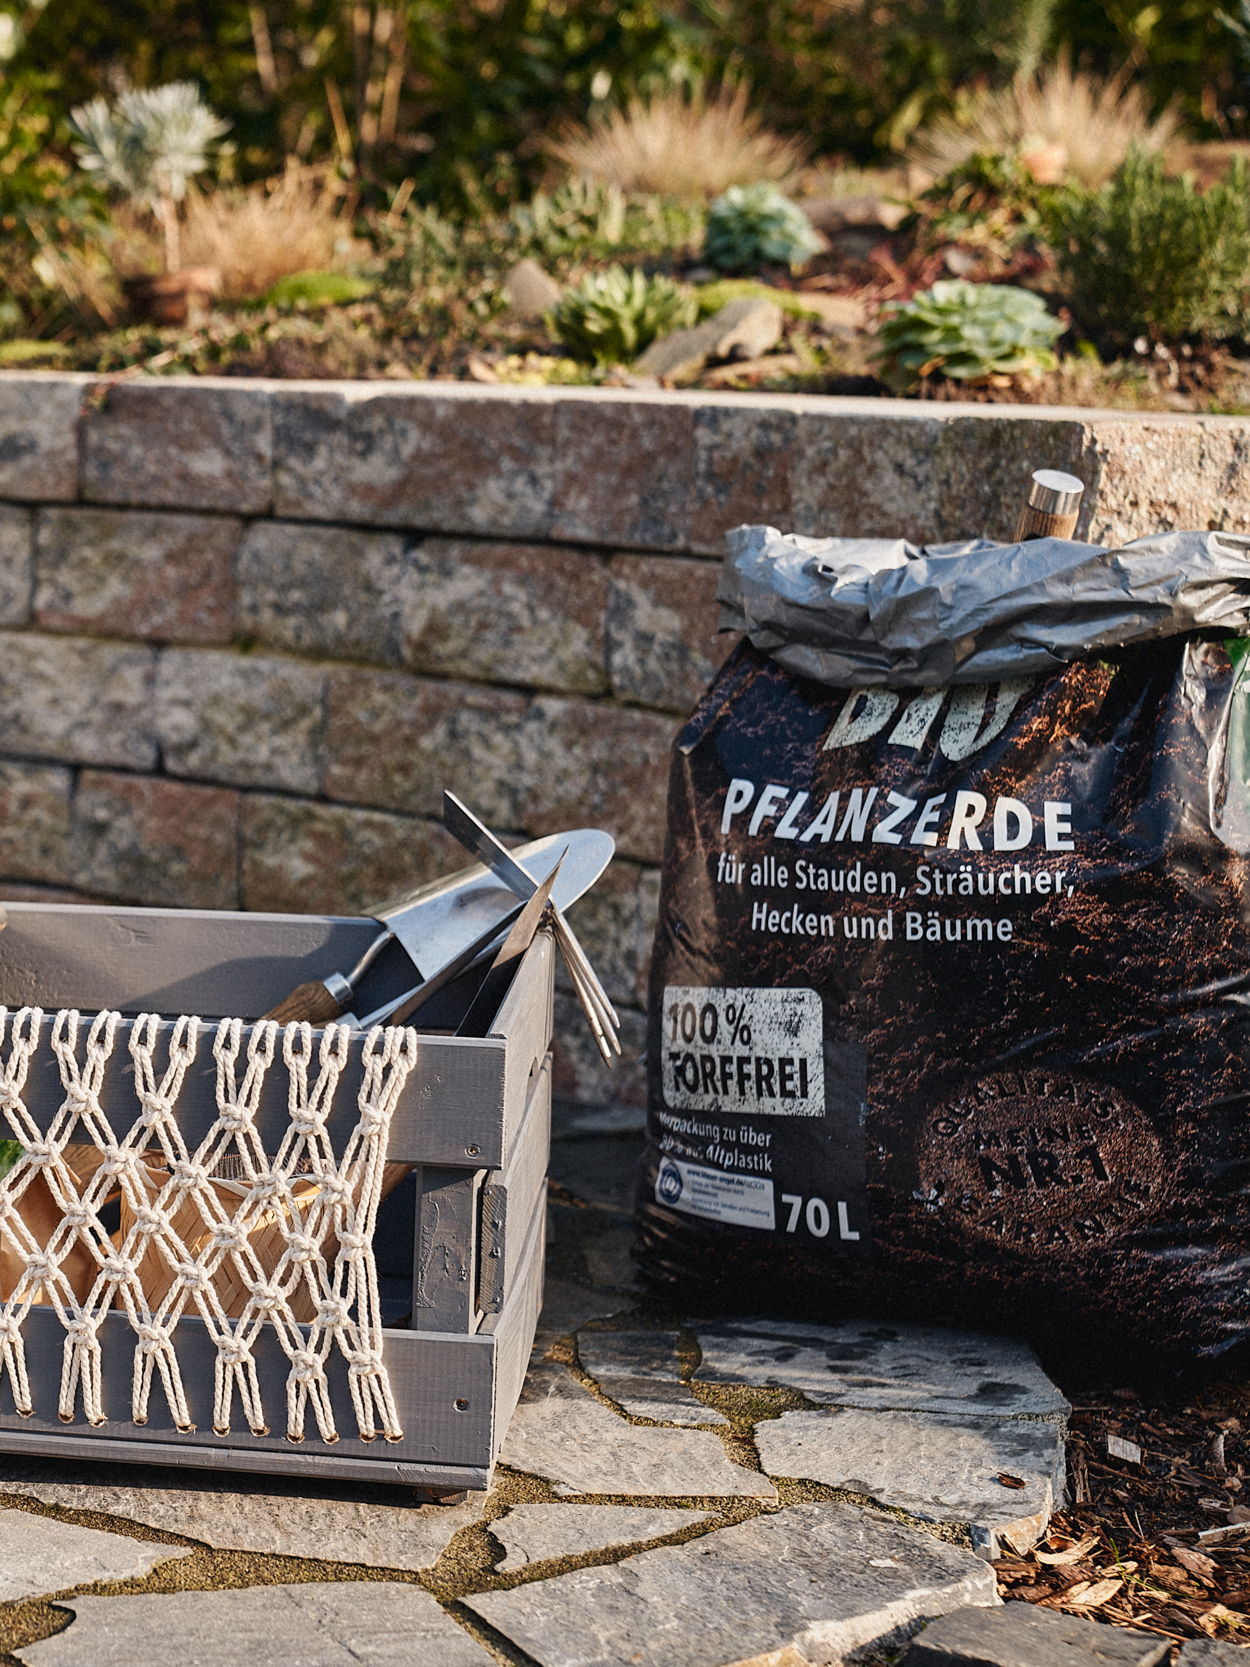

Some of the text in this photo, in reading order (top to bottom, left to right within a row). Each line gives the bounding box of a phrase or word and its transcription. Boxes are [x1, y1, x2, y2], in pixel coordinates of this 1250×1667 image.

[720, 778, 1076, 852] PFLANZERDE
[717, 851, 1076, 899] für alle Stauden, Sträucher,
[751, 901, 1014, 942] Hecken und Bäume
[668, 1052, 809, 1100] TORFFREI
[659, 1111, 772, 1147] Verpackung zu über
[706, 1144, 772, 1172] Altplastik
